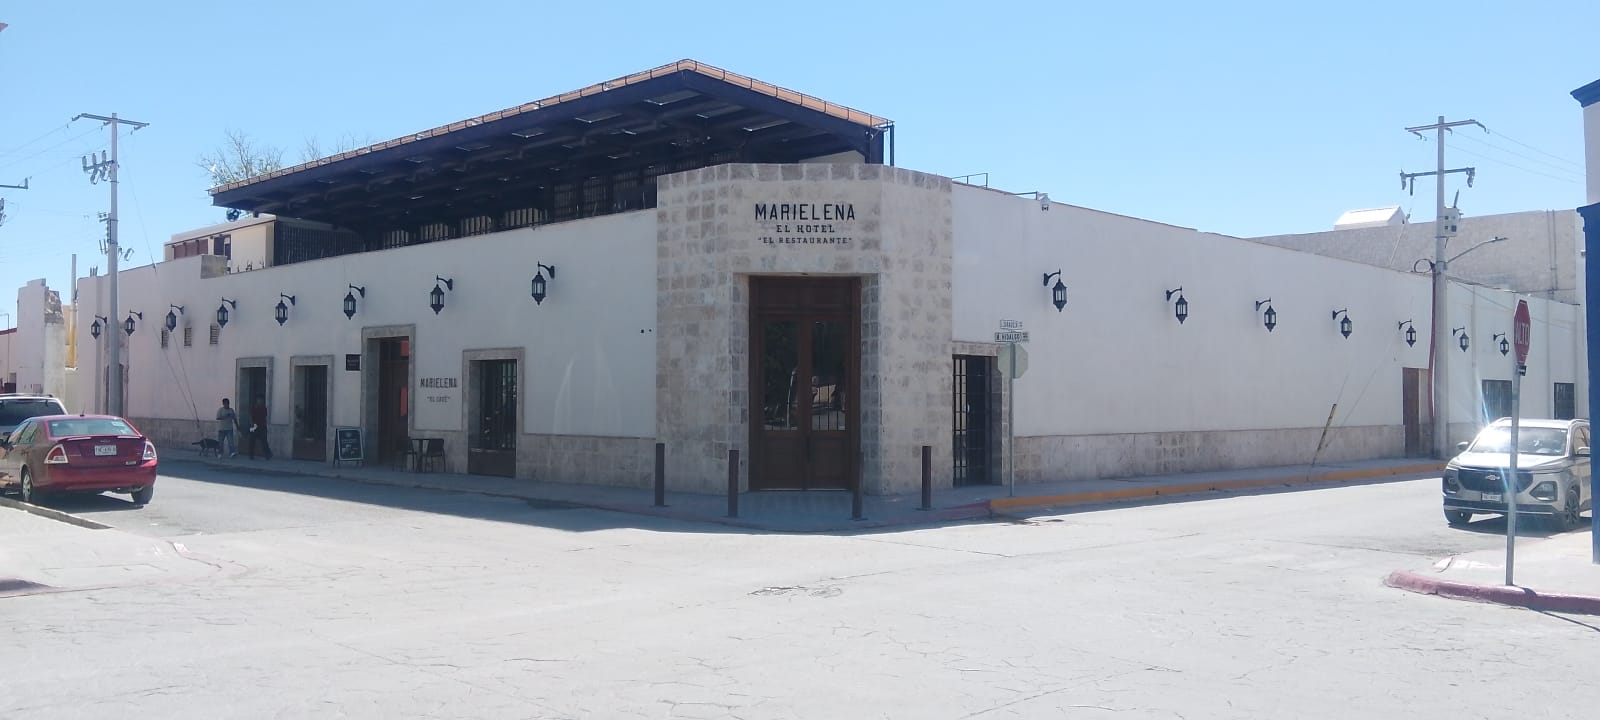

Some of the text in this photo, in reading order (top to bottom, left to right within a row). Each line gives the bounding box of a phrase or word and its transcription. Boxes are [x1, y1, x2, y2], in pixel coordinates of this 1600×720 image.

[755, 203, 855, 221] MARIELENA
[776, 224, 836, 234] EL HOTEL
[1514, 322, 1530, 347] ALTO
[420, 377, 458, 388] MARIELENA
